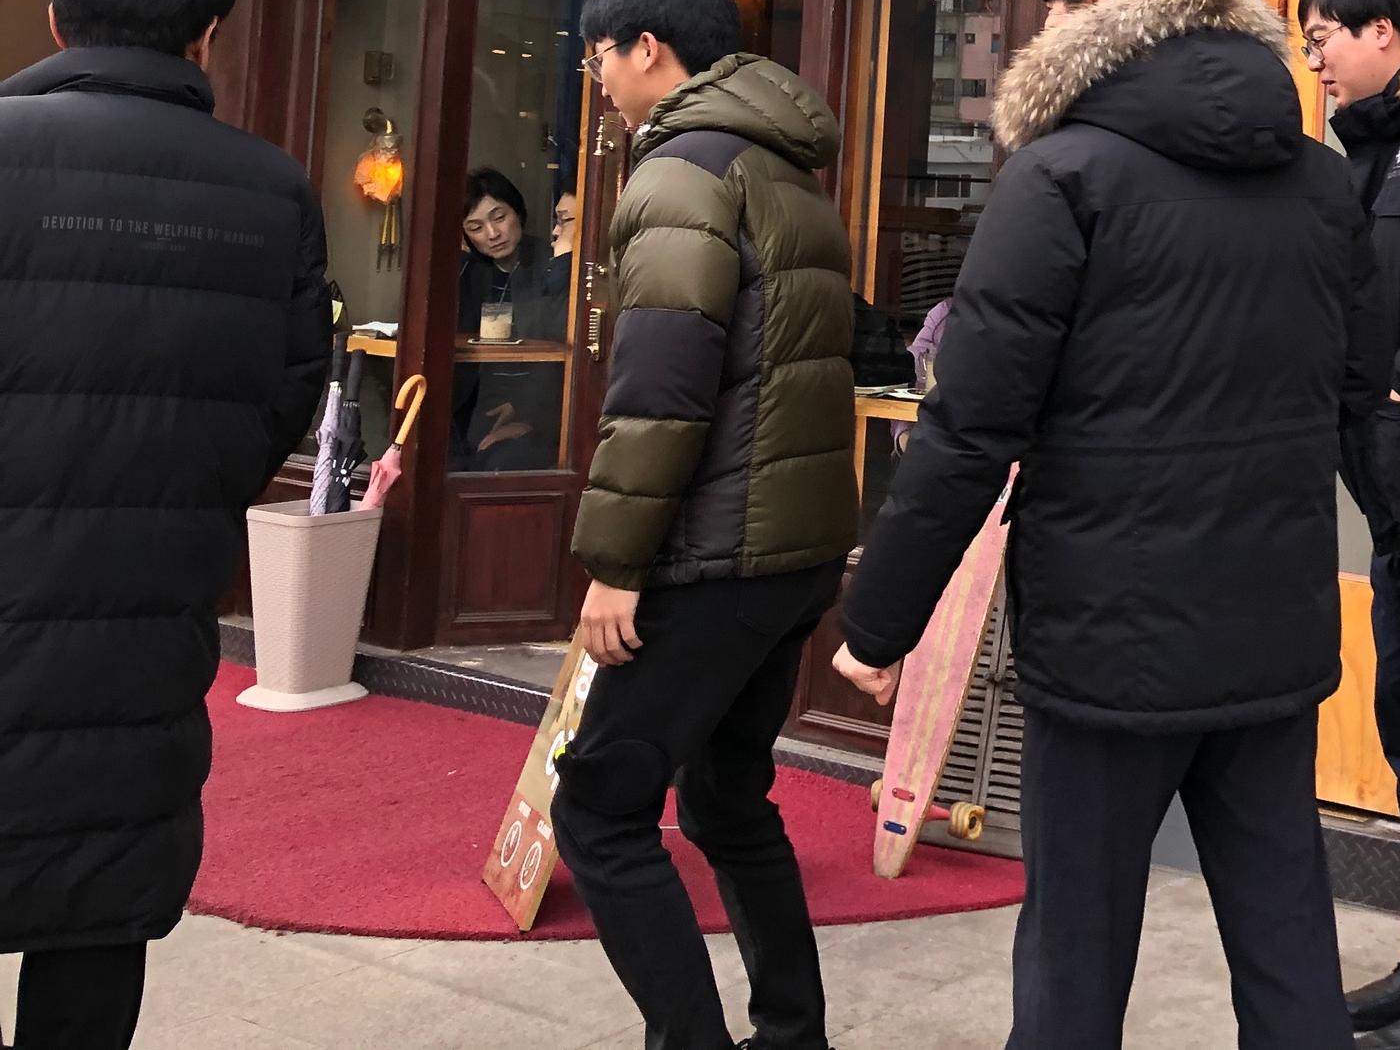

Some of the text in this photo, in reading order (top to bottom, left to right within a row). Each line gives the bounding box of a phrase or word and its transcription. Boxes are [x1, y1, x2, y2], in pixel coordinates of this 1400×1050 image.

[41, 215, 104, 231] DEVOTION
[109, 218, 123, 232] TO
[128, 220, 149, 235] THE
[153, 222, 202, 240] WELFARE
